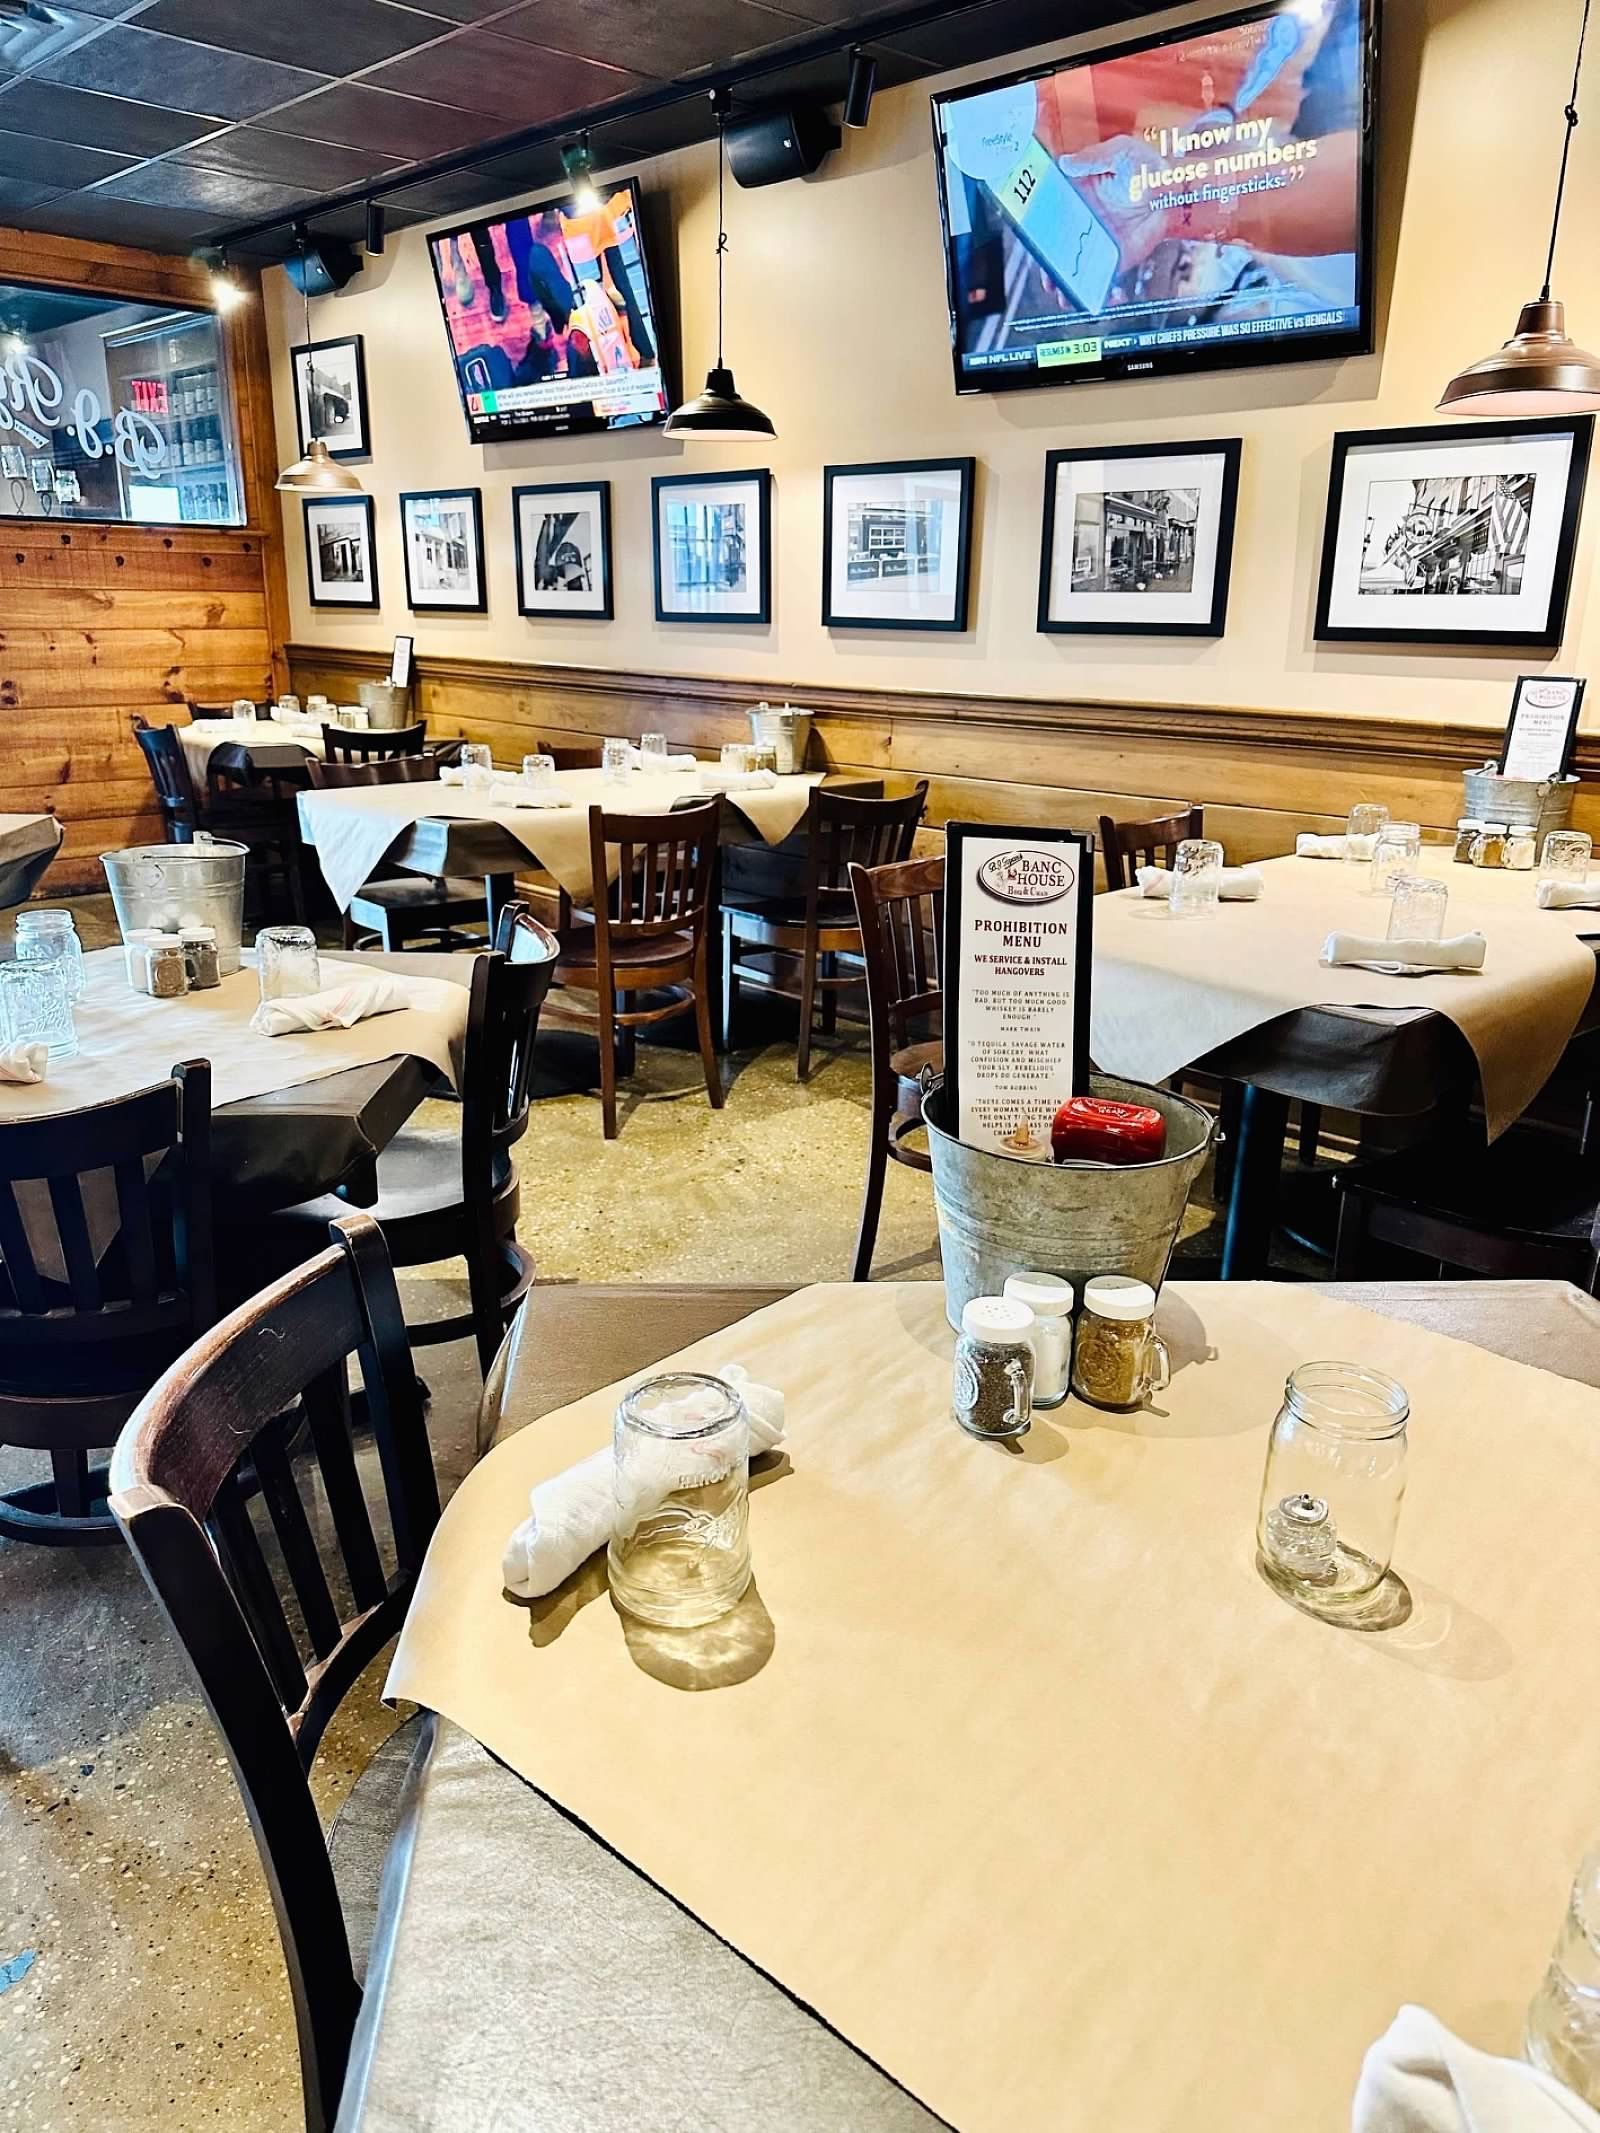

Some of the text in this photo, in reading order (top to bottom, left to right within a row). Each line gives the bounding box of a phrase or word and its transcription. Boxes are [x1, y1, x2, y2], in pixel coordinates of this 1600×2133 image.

[1172, 126, 1232, 152] know
[1235, 117, 1273, 147] my
[1129, 137, 1318, 202] glucose numbers
[1150, 190, 1200, 211] without
[1103, 337, 1132, 349] NEXT
[1183, 326, 1222, 342] PRESSURE
[1222, 324, 1239, 338] WAS
[1240, 322, 1251, 335] SO
[1252, 316, 1294, 333] EFFECTIVE
[1305, 310, 1343, 328] BENGALS
[1073, 341, 1098, 355] 3:03
[1022, 859, 1062, 874] BANC
[1017, 873, 1065, 887] HOUSE
[974, 919, 1068, 935] PROHIBITION
[1002, 935, 1041, 948] MENU
[974, 954, 1067, 966] WE SERVICE & INSTALL
[994, 966, 1045, 976] HANGOVERS
